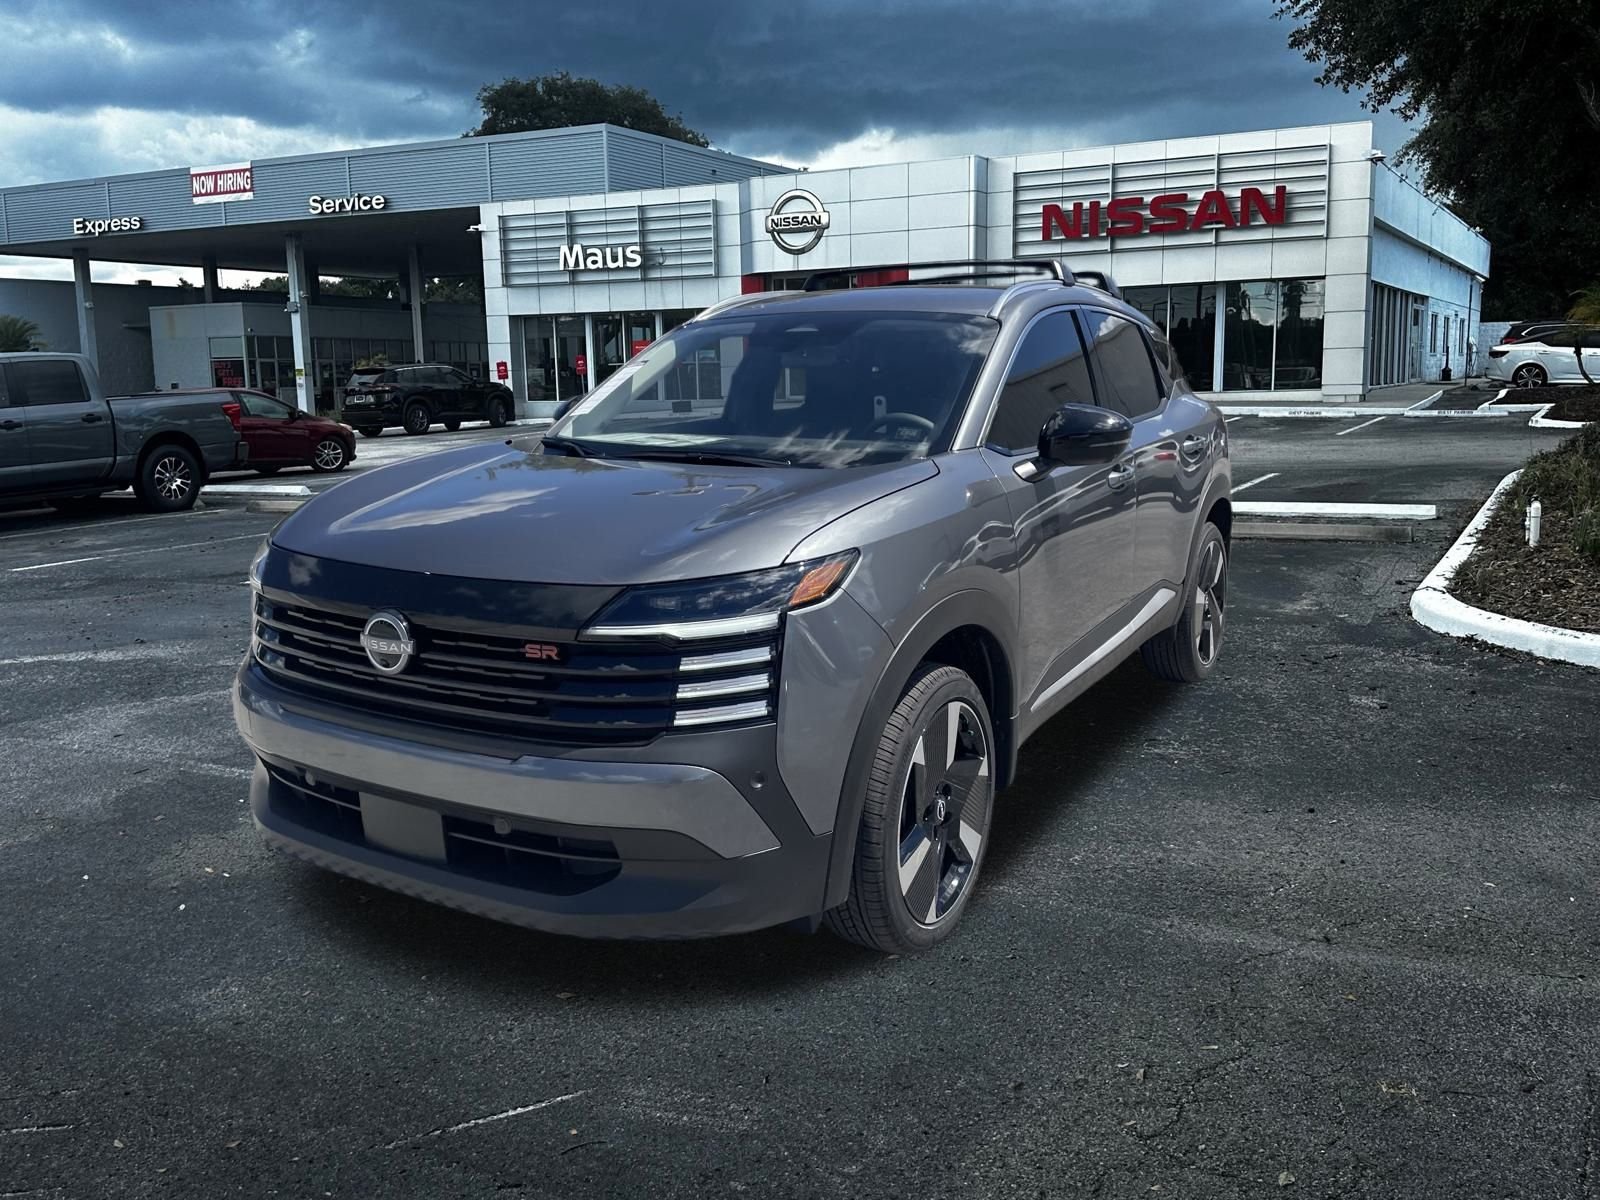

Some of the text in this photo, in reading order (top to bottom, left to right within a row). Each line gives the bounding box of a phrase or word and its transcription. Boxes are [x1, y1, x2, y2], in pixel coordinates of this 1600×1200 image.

[192, 171, 251, 194] NOW HIRING
[309, 193, 385, 214] Service
[1042, 185, 1287, 241] NISSAN
[73, 216, 141, 236] Express
[770, 215, 822, 228] NISSAN
[559, 244, 642, 270] Maus
[525, 644, 560, 660] SR
